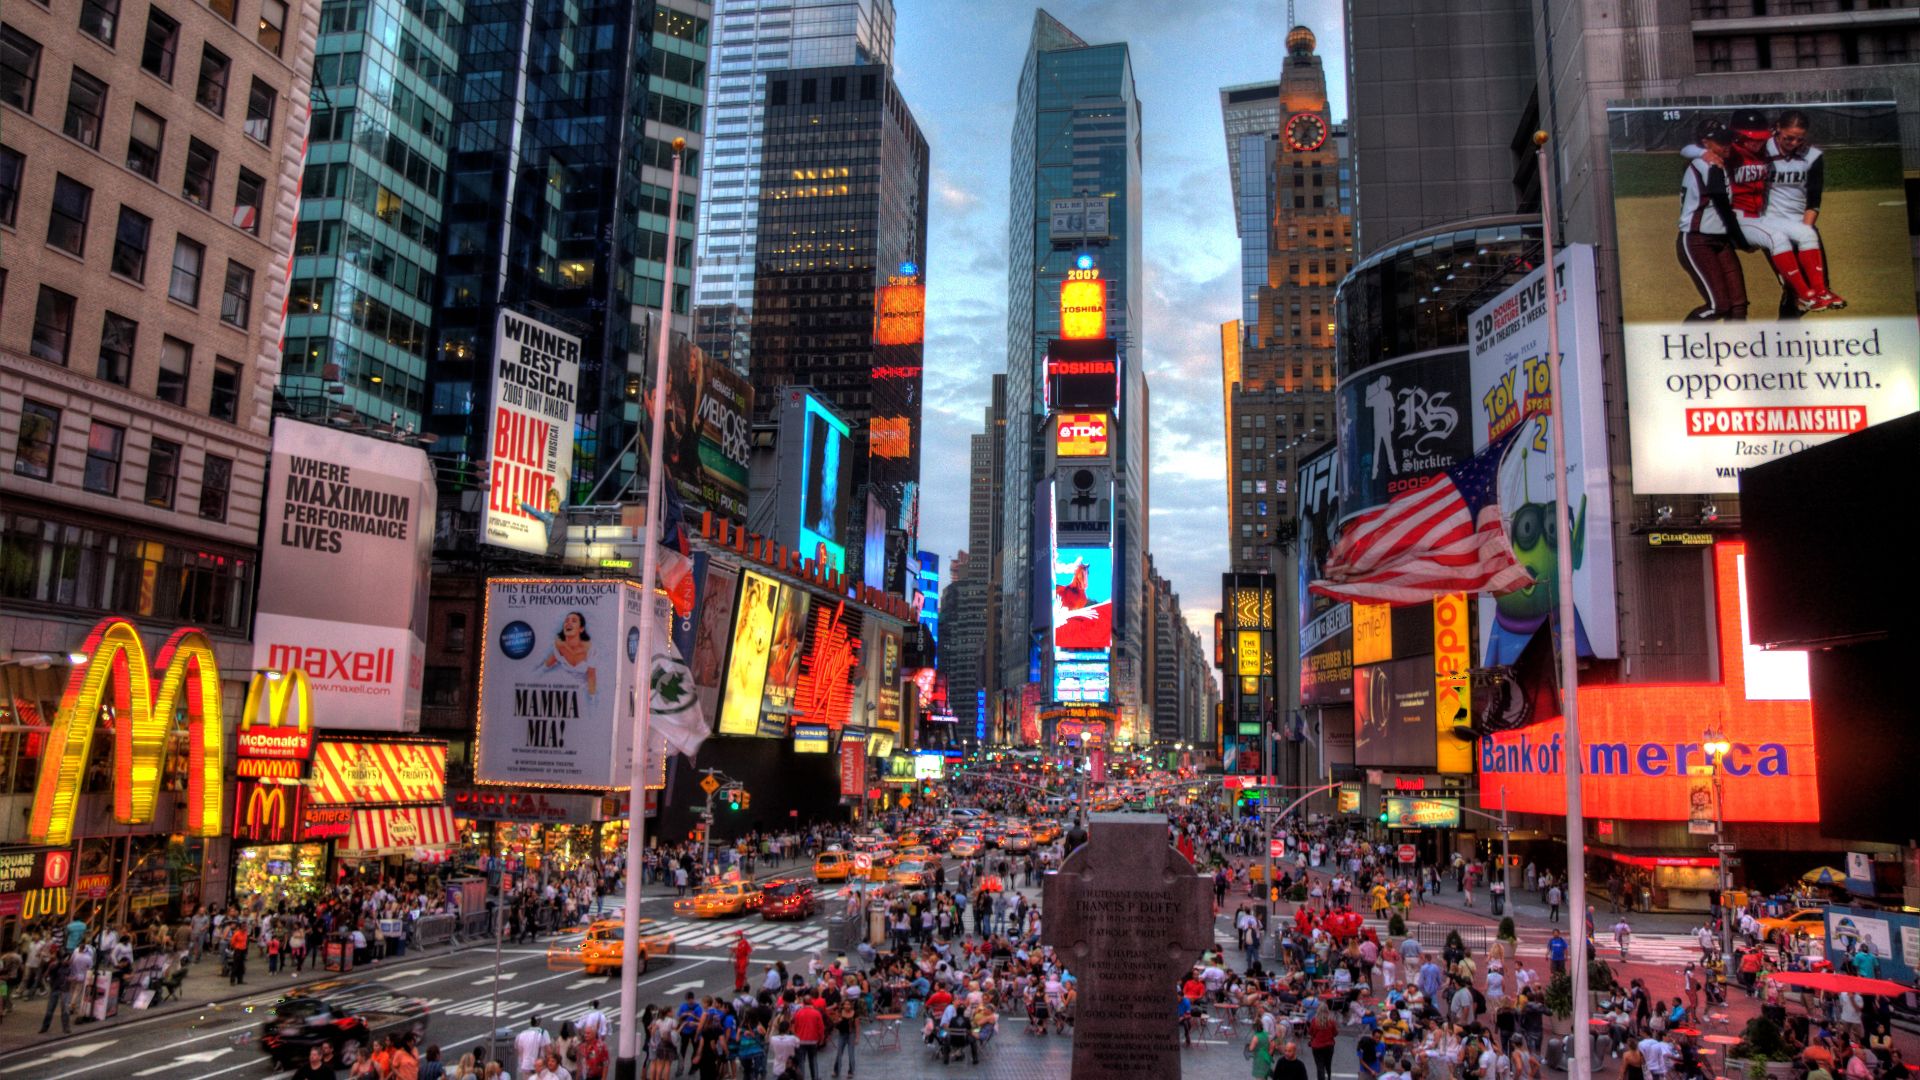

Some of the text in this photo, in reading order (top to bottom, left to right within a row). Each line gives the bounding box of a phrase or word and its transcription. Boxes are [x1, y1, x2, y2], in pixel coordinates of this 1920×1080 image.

[1663, 110, 1681, 121] 215
[1068, 269, 1099, 280] 2009
[1475, 313, 1494, 342] 3D
[1493, 293, 1520, 319] DOUBLE
[1519, 261, 1566, 315] EVET
[1494, 305, 1520, 331] FEATURE
[504, 315, 579, 365] WINNER
[1661, 328, 1883, 367] Helped injured
[519, 346, 562, 377] BEST
[1050, 361, 1116, 374] TOSHIBA
[499, 358, 576, 404] MUSICAL
[1482, 364, 1518, 424] TOY
[1665, 362, 1882, 400] opponent win.
[502, 382, 569, 423] 2009 TONY AWARD
[697, 393, 748, 440] MELROSE
[1526, 396, 1550, 412] STOR
[1070, 426, 1103, 437] TDK
[1532, 411, 1548, 454] 2
[1691, 409, 1862, 433] SPORTSMANSHIP
[494, 406, 550, 470] BILLY
[721, 431, 750, 469] PLACE
[1735, 440, 1768, 456] Pass
[1771, 439, 1785, 455] It
[290, 455, 350, 484] WHERE
[1401, 454, 1453, 473] Sheckler
[286, 474, 409, 522] MAXIMUM
[490, 459, 555, 522] ELLIOT
[284, 503, 408, 541] PERFORMANCE
[1057, 521, 1110, 532] CHEVROLET
[281, 522, 343, 554] LIVES
[508, 595, 519, 605] IS
[519, 595, 527, 605] A
[520, 583, 573, 595] FEEL-GOOD
[576, 584, 619, 595] MUSICAL
[1357, 612, 1387, 641] smile?
[269, 643, 395, 684] maxell
[1241, 648, 1258, 658] LION
[1241, 660, 1258, 669] KING
[513, 689, 579, 719] MAMMA
[239, 734, 308, 748] McDonald's
[525, 719, 566, 748] MIA!
[249, 747, 295, 756] Restaurant
[1481, 733, 1789, 776] Bank of merica
[347, 768, 378, 780] FRIDAY'S
[401, 768, 430, 780] FRIDAY'S
[456, 791, 549, 808] DIGITAL
[1076, 901, 1182, 913] FRANCIS DUFFY
[1088, 928, 1130, 937] CATHOLIC
